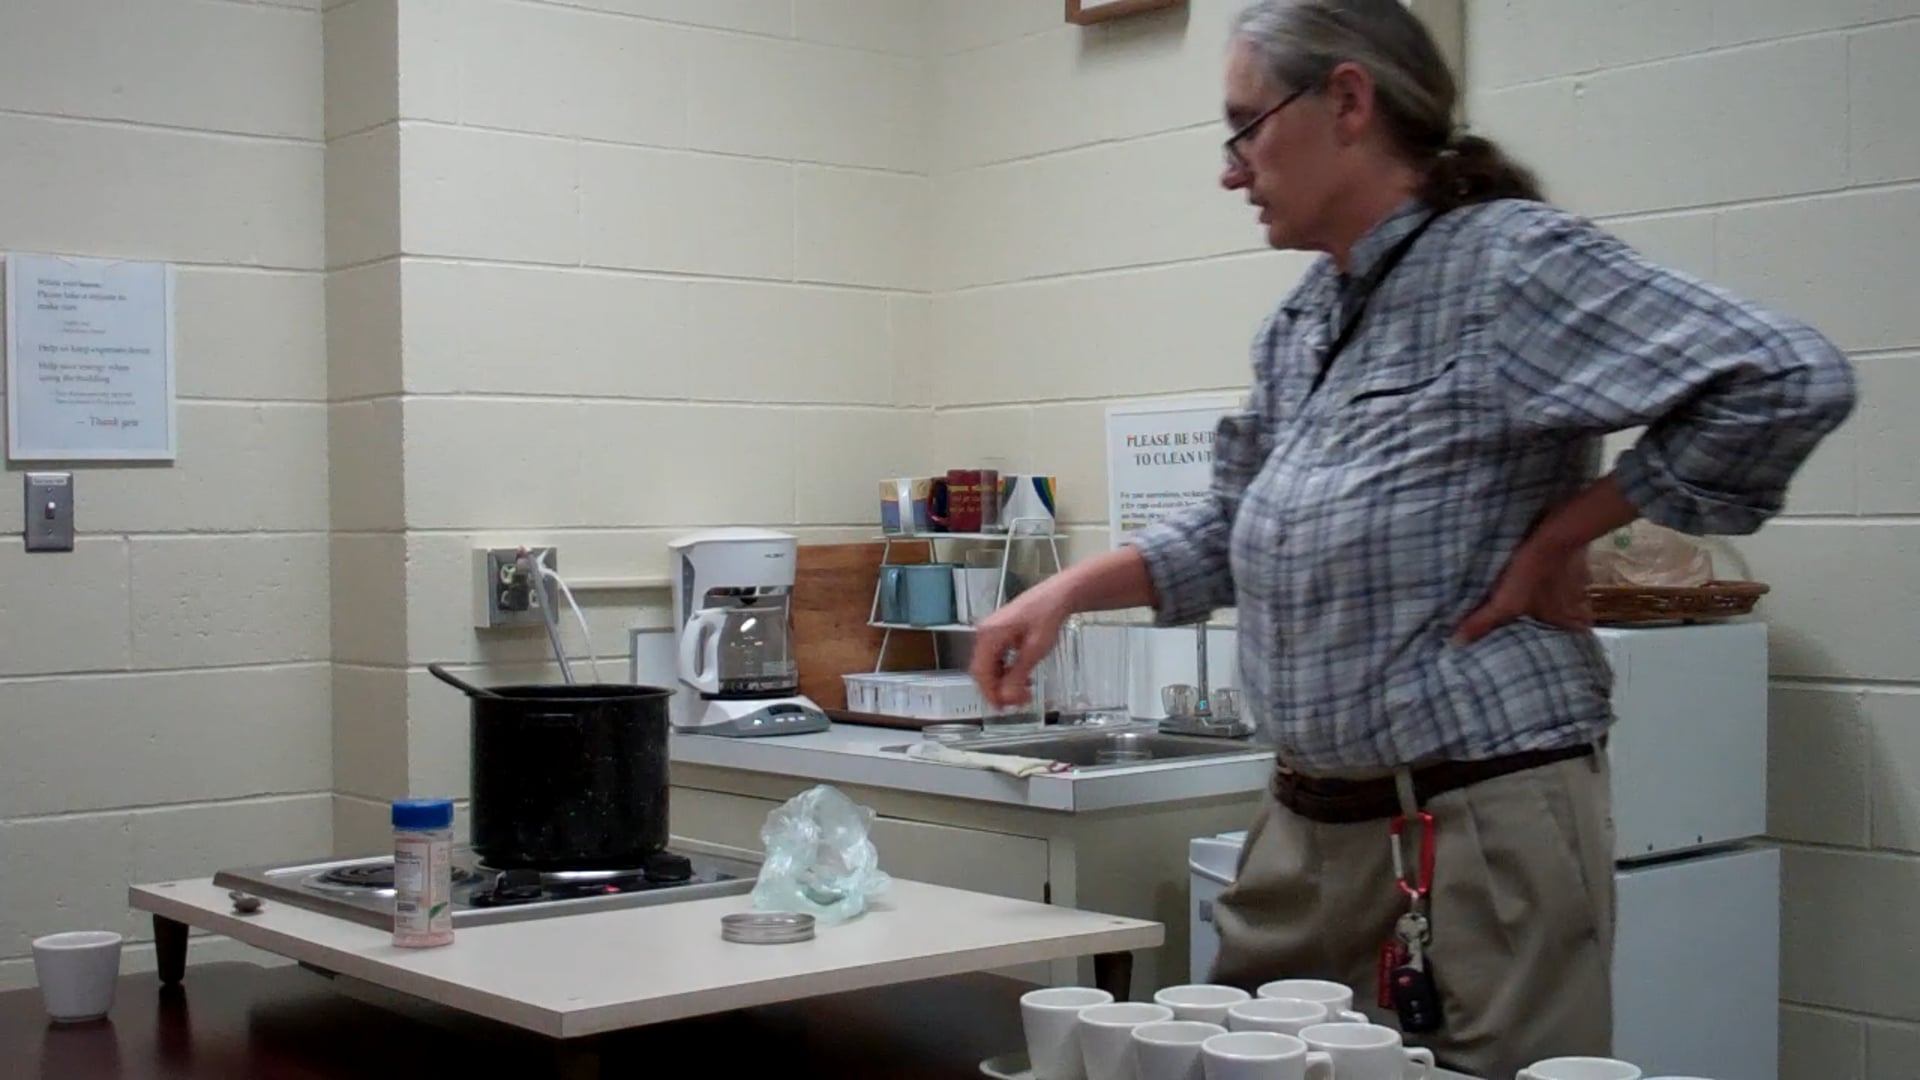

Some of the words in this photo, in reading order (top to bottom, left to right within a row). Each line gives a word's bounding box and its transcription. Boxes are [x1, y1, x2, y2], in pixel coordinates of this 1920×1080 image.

[38, 344, 58, 354] Help
[89, 415, 118, 427] Thank
[121, 419, 139, 430] you
[1127, 433, 1171, 447] PLEASE
[1174, 431, 1189, 447] BE
[1134, 452, 1151, 467] TO
[1153, 450, 1195, 466] CLEAN
